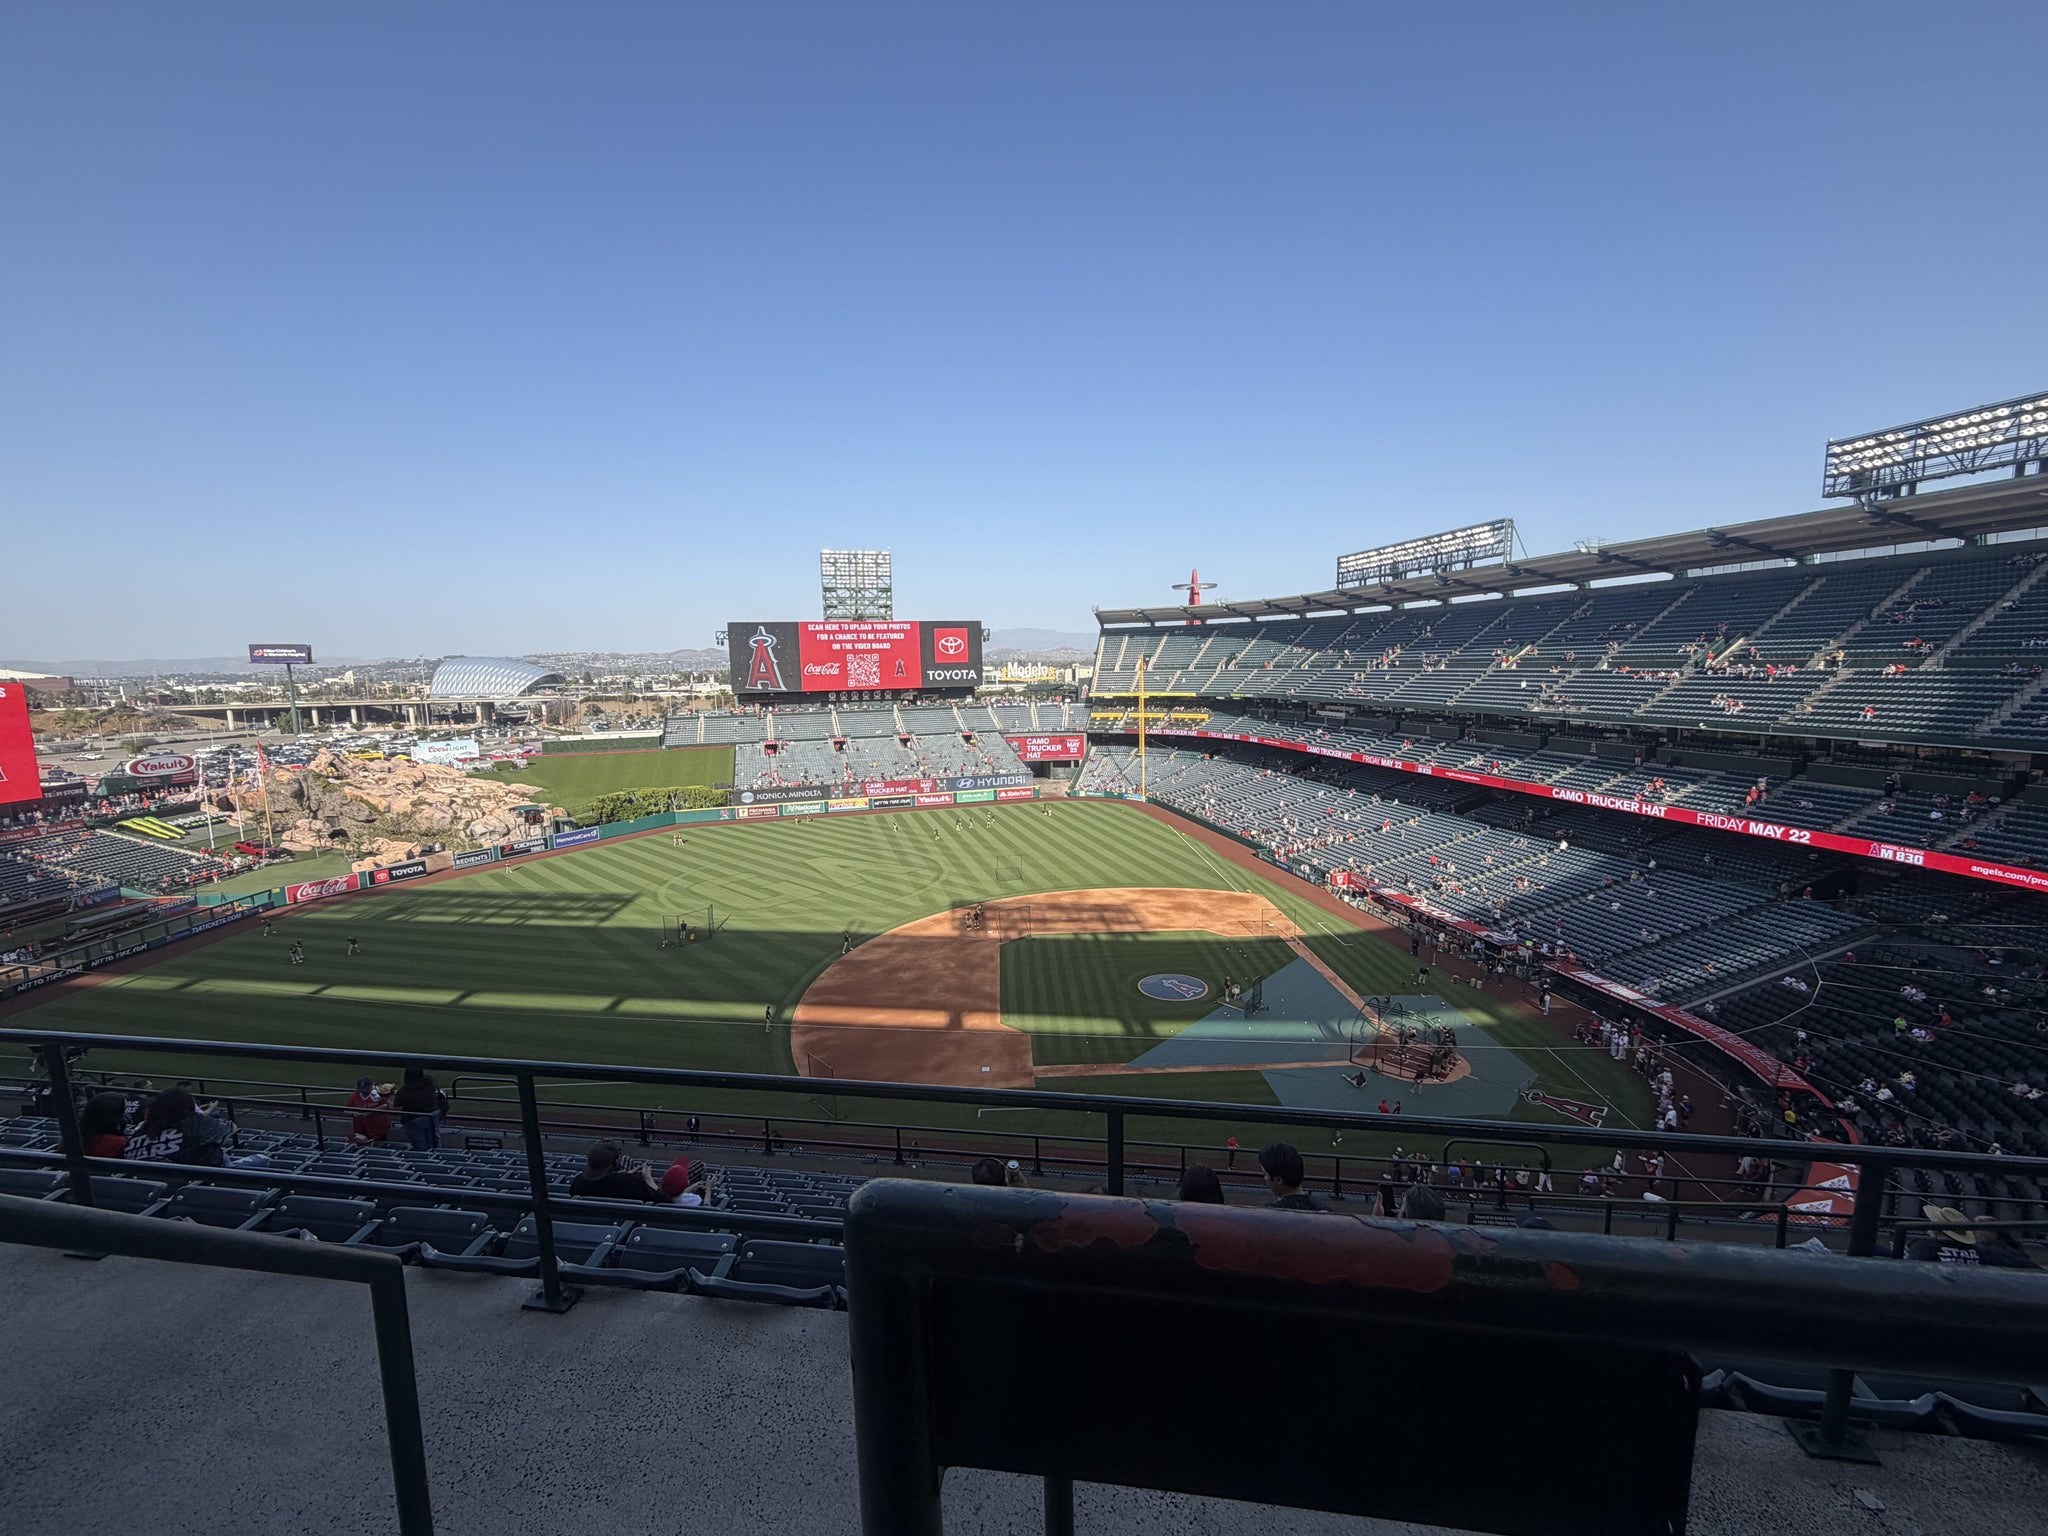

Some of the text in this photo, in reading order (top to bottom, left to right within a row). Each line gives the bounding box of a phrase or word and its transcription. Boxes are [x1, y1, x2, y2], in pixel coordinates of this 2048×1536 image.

[804, 662, 841, 676] Coca-Cola
[927, 669, 977, 680] TOYOTA
[1007, 662, 1048, 678] Modelo
[1026, 744, 1062, 752] TRUCKER
[1306, 746, 1352, 760] CAMO TRUCKER HAT
[142, 760, 186, 771] Yakult
[1362, 755, 1380, 764] FRIDAY
[1381, 758, 1393, 766] MAY
[978, 776, 1026, 786] HYUNDAI
[756, 790, 822, 800] KONICA MINOLTA
[918, 794, 951, 803] Yakult
[1552, 788, 1667, 818] CAMO TRUCKER HAT
[1697, 813, 1811, 844] FRIDAY MAY 22
[513, 839, 545, 849] YOKOHAMA
[556, 833, 591, 843] MemorialCare
[1881, 844, 1904, 852] ANGELS
[1896, 852, 1924, 865] 830
[391, 866, 424, 876] TOYOTA
[1971, 865, 2048, 886] angels.com/pro
[297, 876, 350, 899] Coca-Cola
[192, 912, 241, 933] 714TICKETS.COM
[91, 943, 147, 967] NITTO TIRE.COM
[18, 965, 82, 992] NITTO TIRE.COM
[124, 1138, 184, 1160] WARS
[1937, 1246, 1980, 1259] STAR
